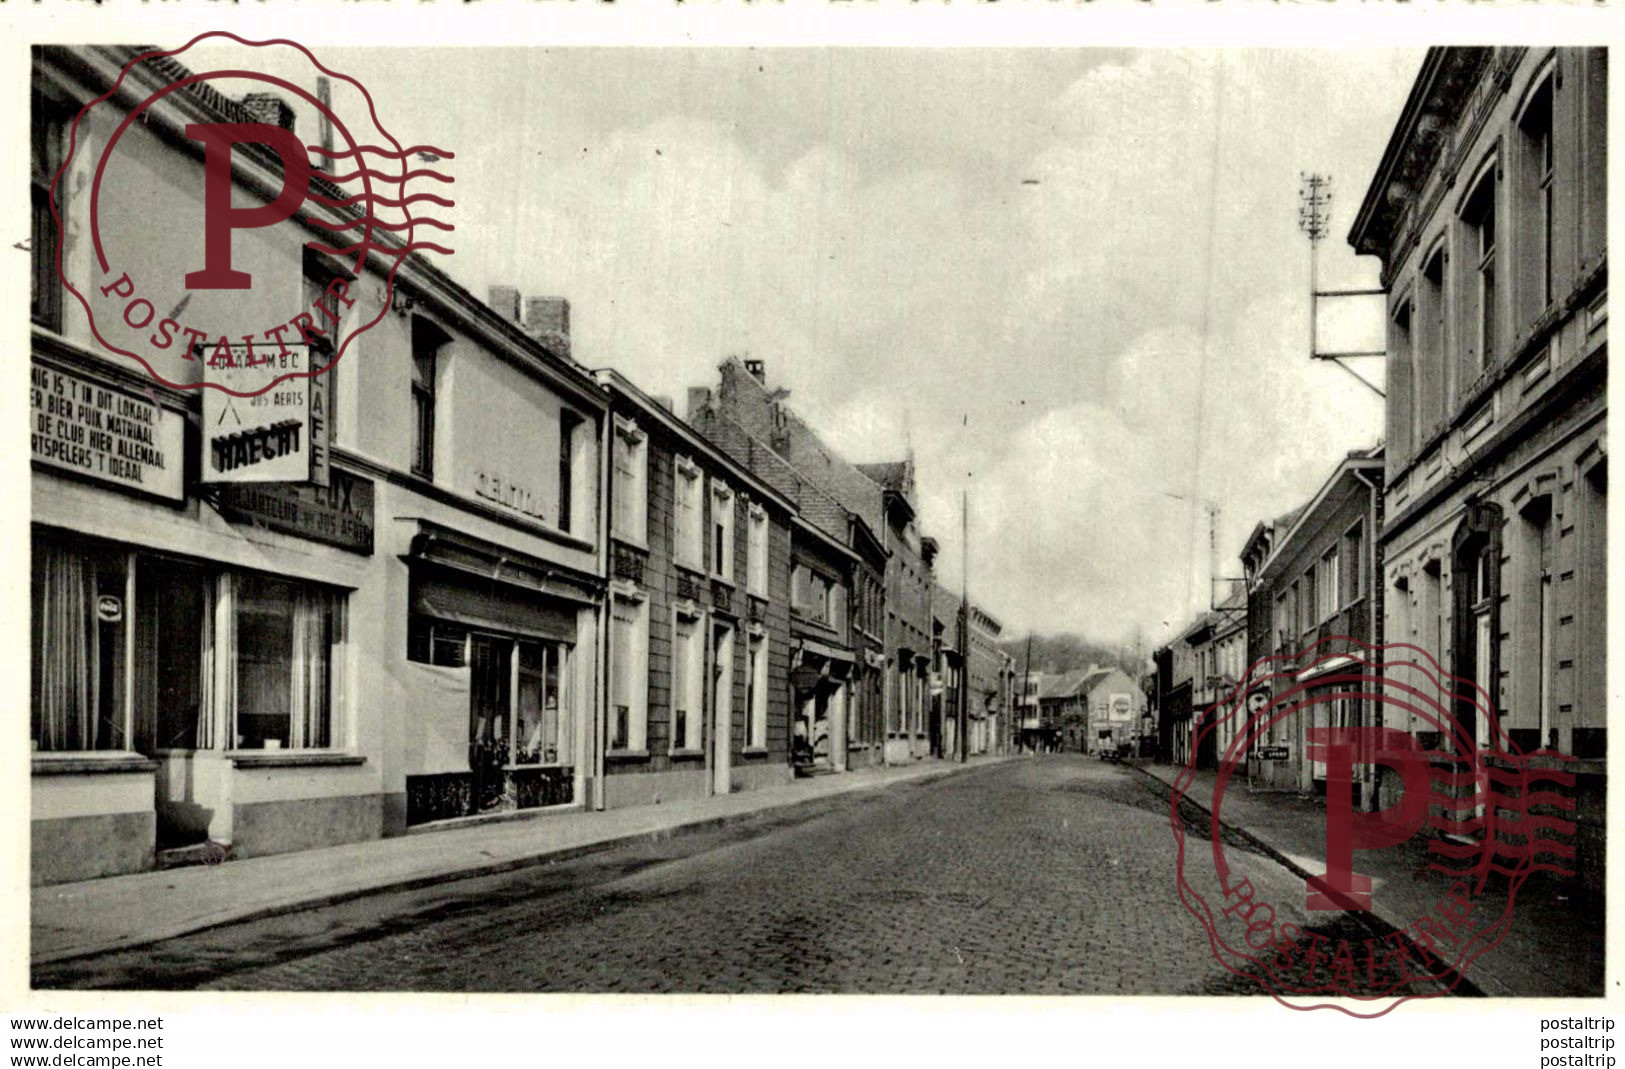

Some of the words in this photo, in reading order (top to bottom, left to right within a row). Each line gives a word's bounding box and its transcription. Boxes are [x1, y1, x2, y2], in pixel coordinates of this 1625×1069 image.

[48, 394, 73, 420] BIER
[106, 414, 154, 446] MATRIAAL
[53, 374, 64, 396] IS
[82, 385, 92, 404] IN
[97, 391, 113, 412] DIT
[117, 397, 153, 426] LOKAAL
[274, 392, 303, 407] AERTS
[57, 419, 84, 445] CLUB
[89, 429, 113, 455] HIER
[118, 438, 166, 470] ALLEMAAL
[109, 457, 143, 483] IDEAAL
[211, 419, 303, 474] HAECHT
